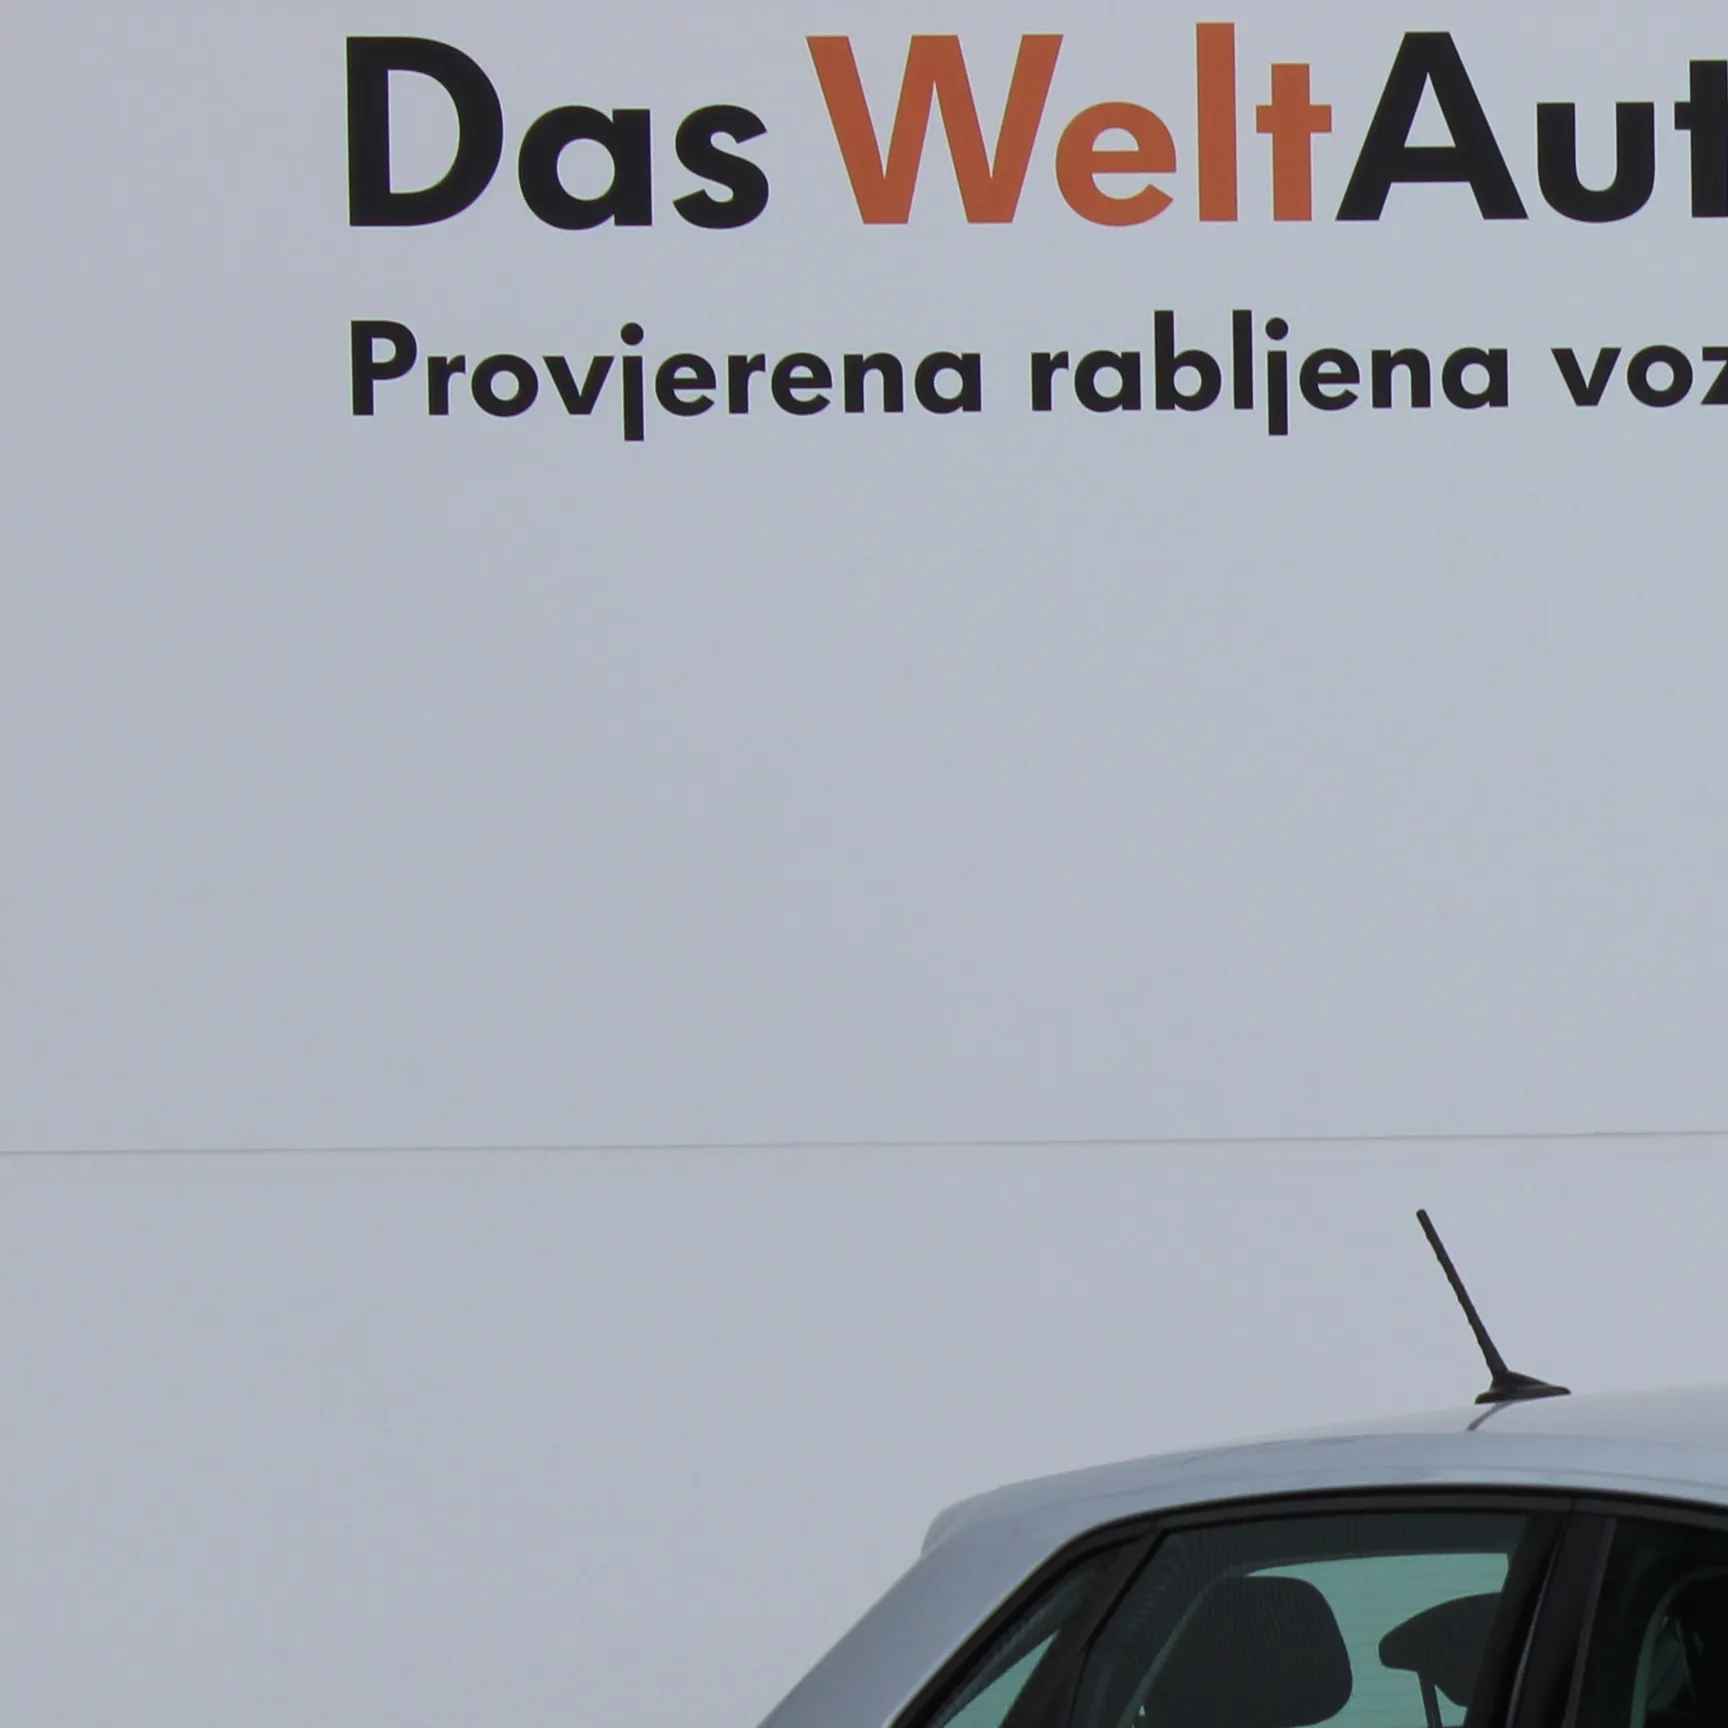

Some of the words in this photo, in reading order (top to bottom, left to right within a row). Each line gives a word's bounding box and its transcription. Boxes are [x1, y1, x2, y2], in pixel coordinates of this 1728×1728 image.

[346, 36, 768, 230] Das
[351, 321, 981, 441] Provjerena
[1032, 310, 1508, 435] rabljena
